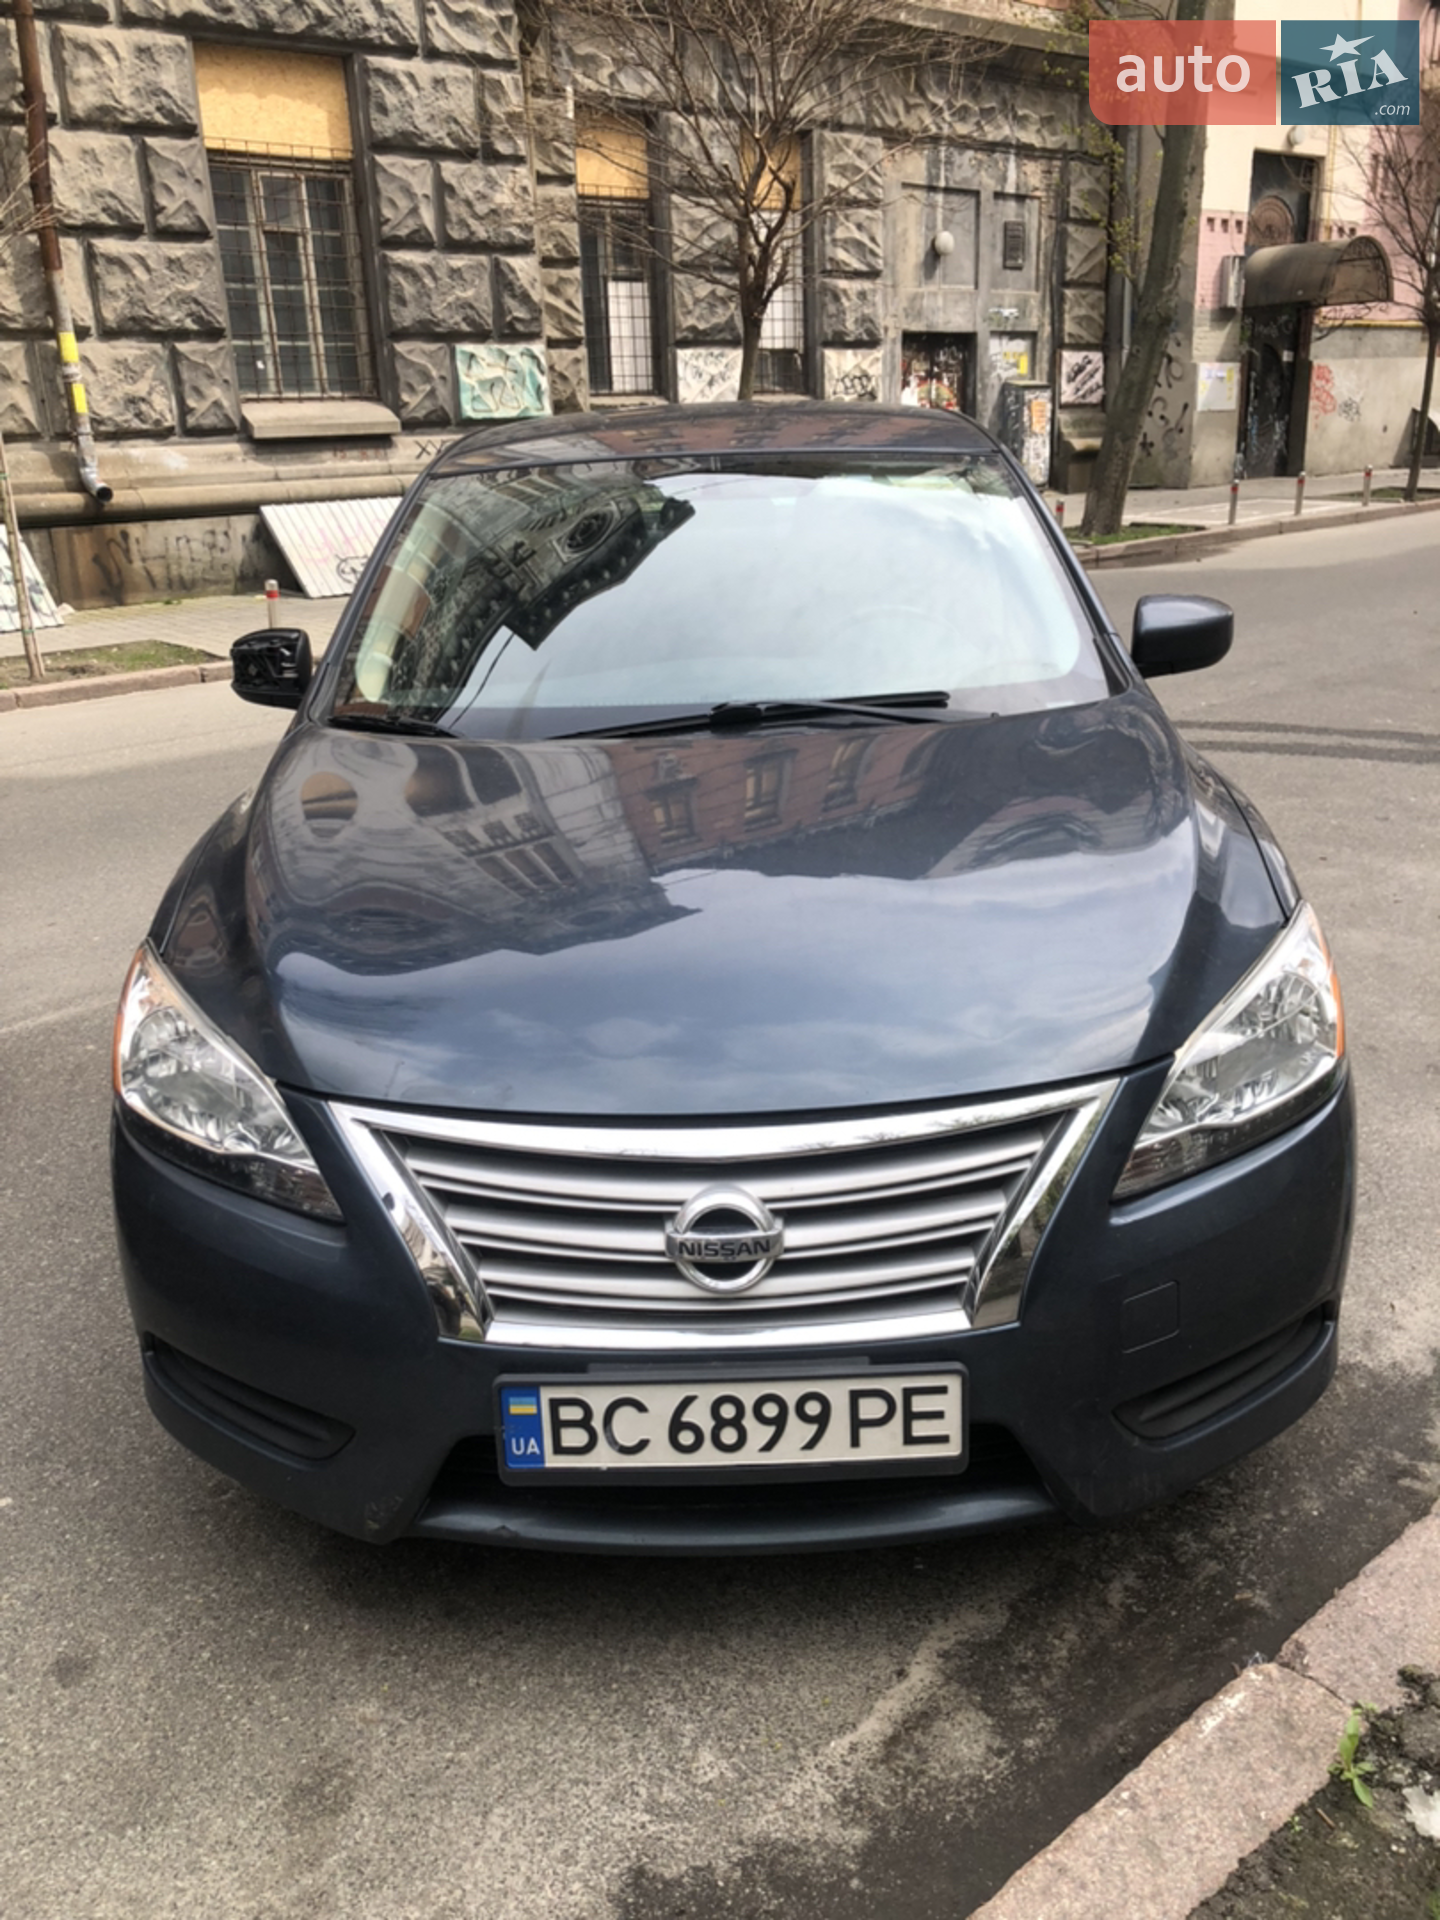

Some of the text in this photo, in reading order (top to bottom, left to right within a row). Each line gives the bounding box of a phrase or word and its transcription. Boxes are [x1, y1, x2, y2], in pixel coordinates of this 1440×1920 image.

[678, 1239, 770, 1257] NISSAN
[548, 1385, 950, 1456] BC 6899 PE
[511, 1437, 541, 1456] UA
